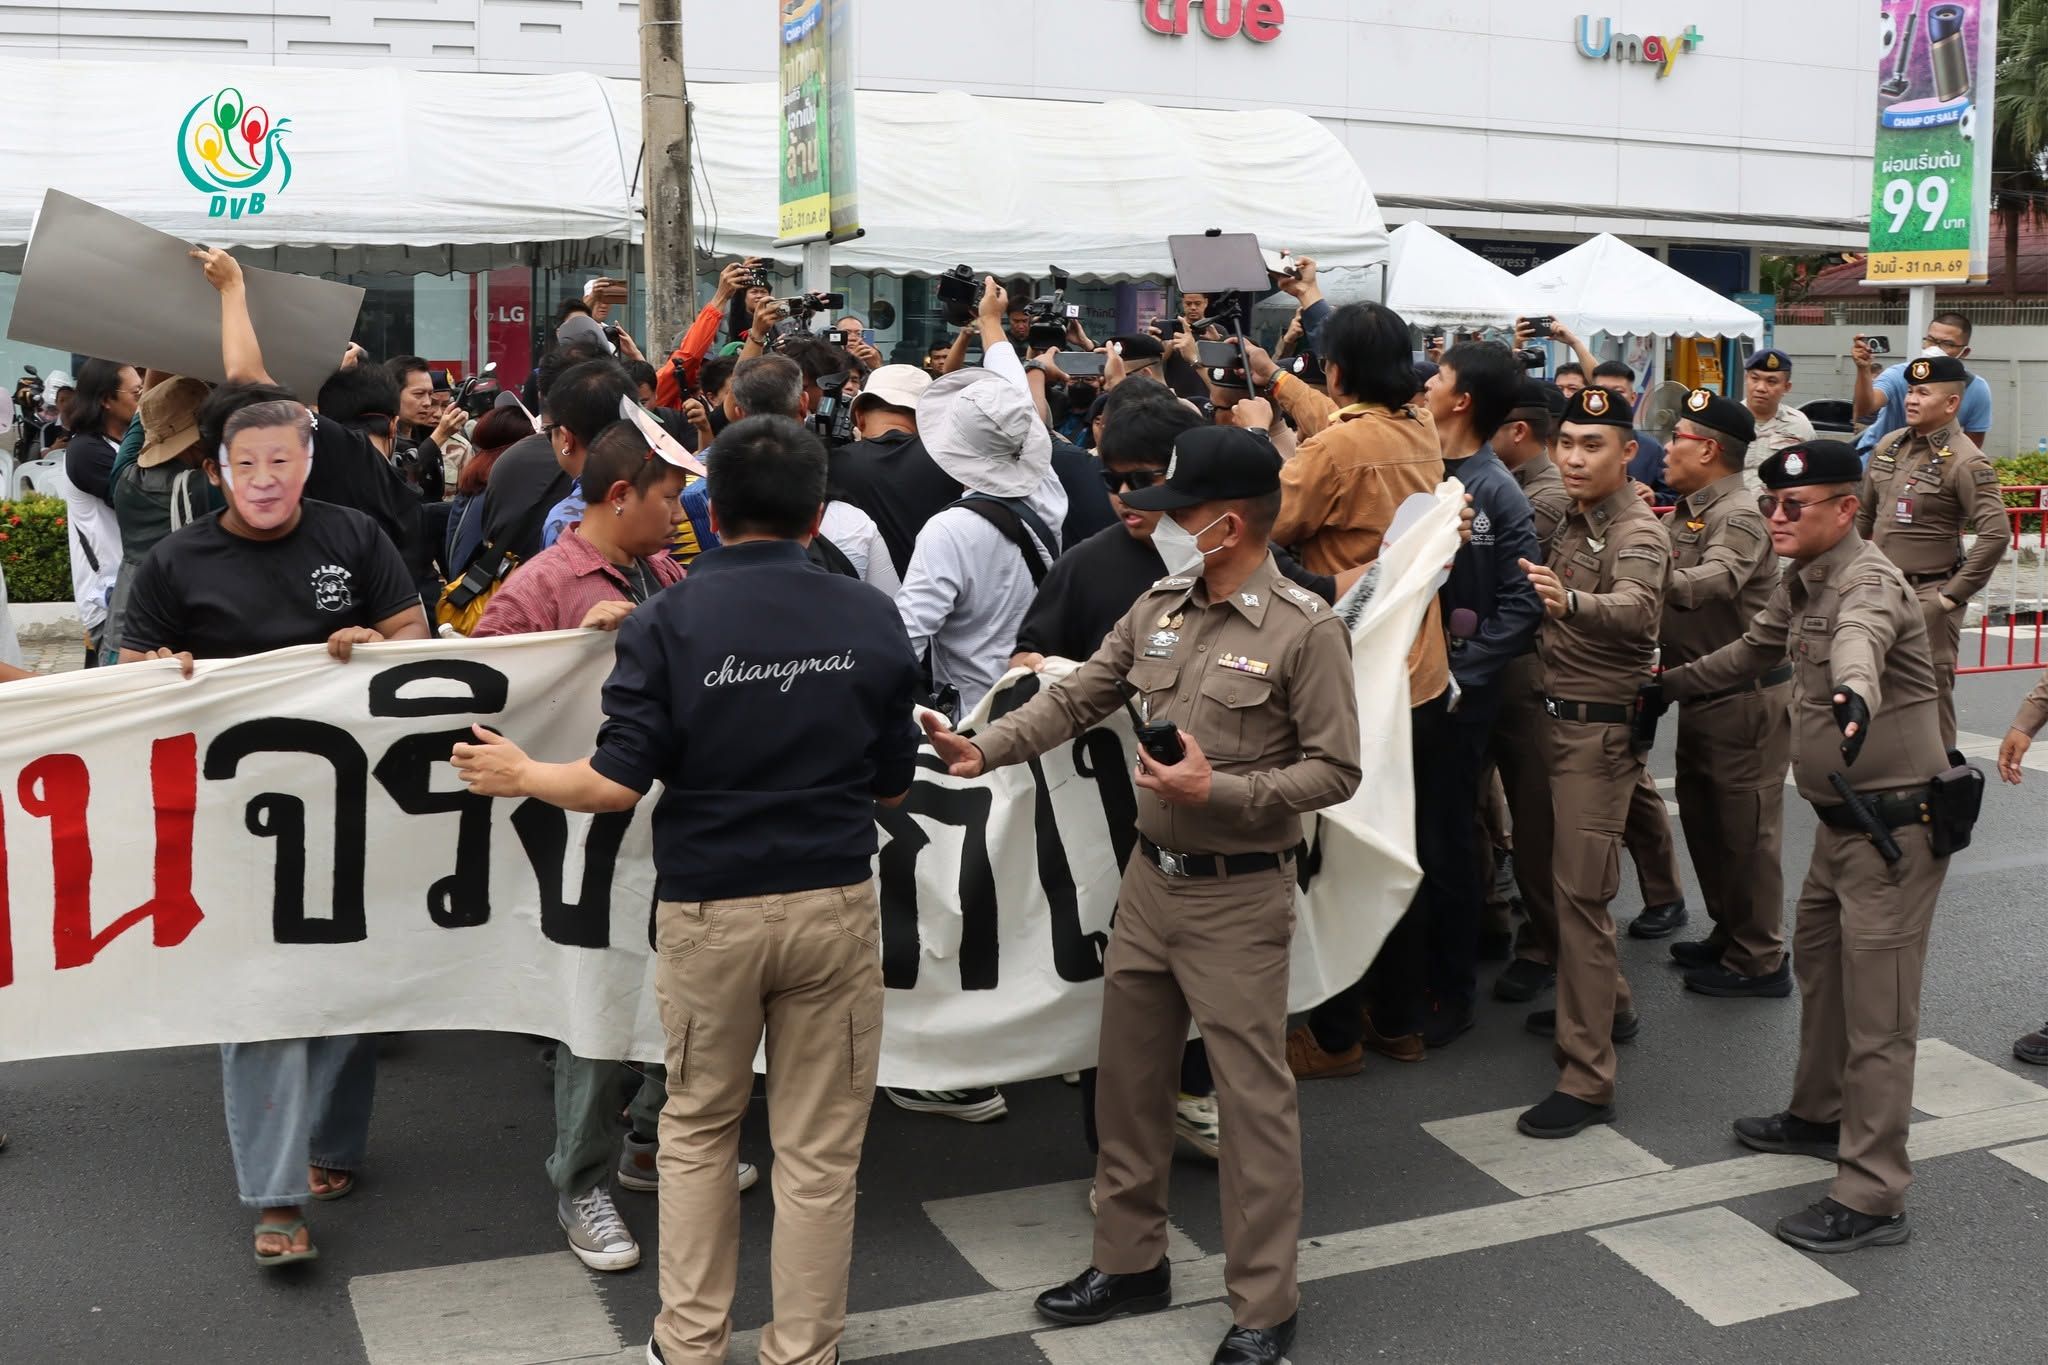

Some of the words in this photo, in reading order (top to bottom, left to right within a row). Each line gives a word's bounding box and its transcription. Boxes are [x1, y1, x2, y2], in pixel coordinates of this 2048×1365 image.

[1142, 0, 1285, 44] true
[1893, 116, 1922, 127] CHAMP
[1924, 114, 1935, 125] OF
[1936, 110, 1959, 123] SALE
[1882, 149, 1961, 173] ผ่อนเริ่มต้น
[1943, 217, 1966, 230] บาท
[1873, 256, 1897, 274] วันนี้
[1906, 262, 1920, 273] 31
[1922, 261, 1945, 273] ก.ค.
[1948, 260, 1963, 272] 69
[498, 305, 525, 323] LG
[320, 564, 353, 580] LEFT
[703, 648, 856, 693] chiangmai
